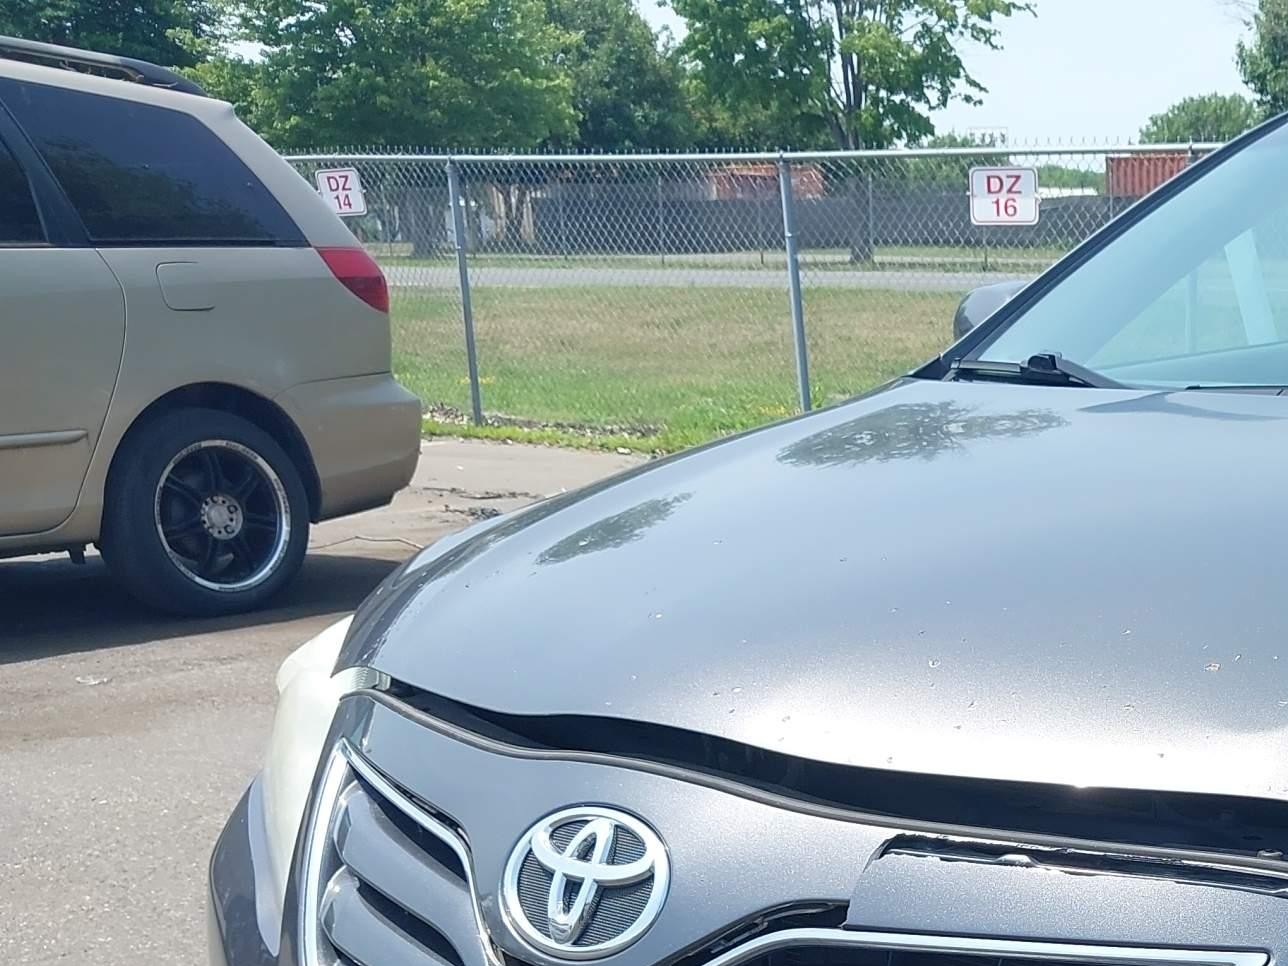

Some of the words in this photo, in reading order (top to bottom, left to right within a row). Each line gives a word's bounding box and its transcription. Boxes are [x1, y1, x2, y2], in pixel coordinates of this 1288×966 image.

[326, 175, 352, 192] DZ
[986, 175, 1022, 195] DZ
[334, 194, 353, 210] 14
[992, 197, 1018, 217] 16
